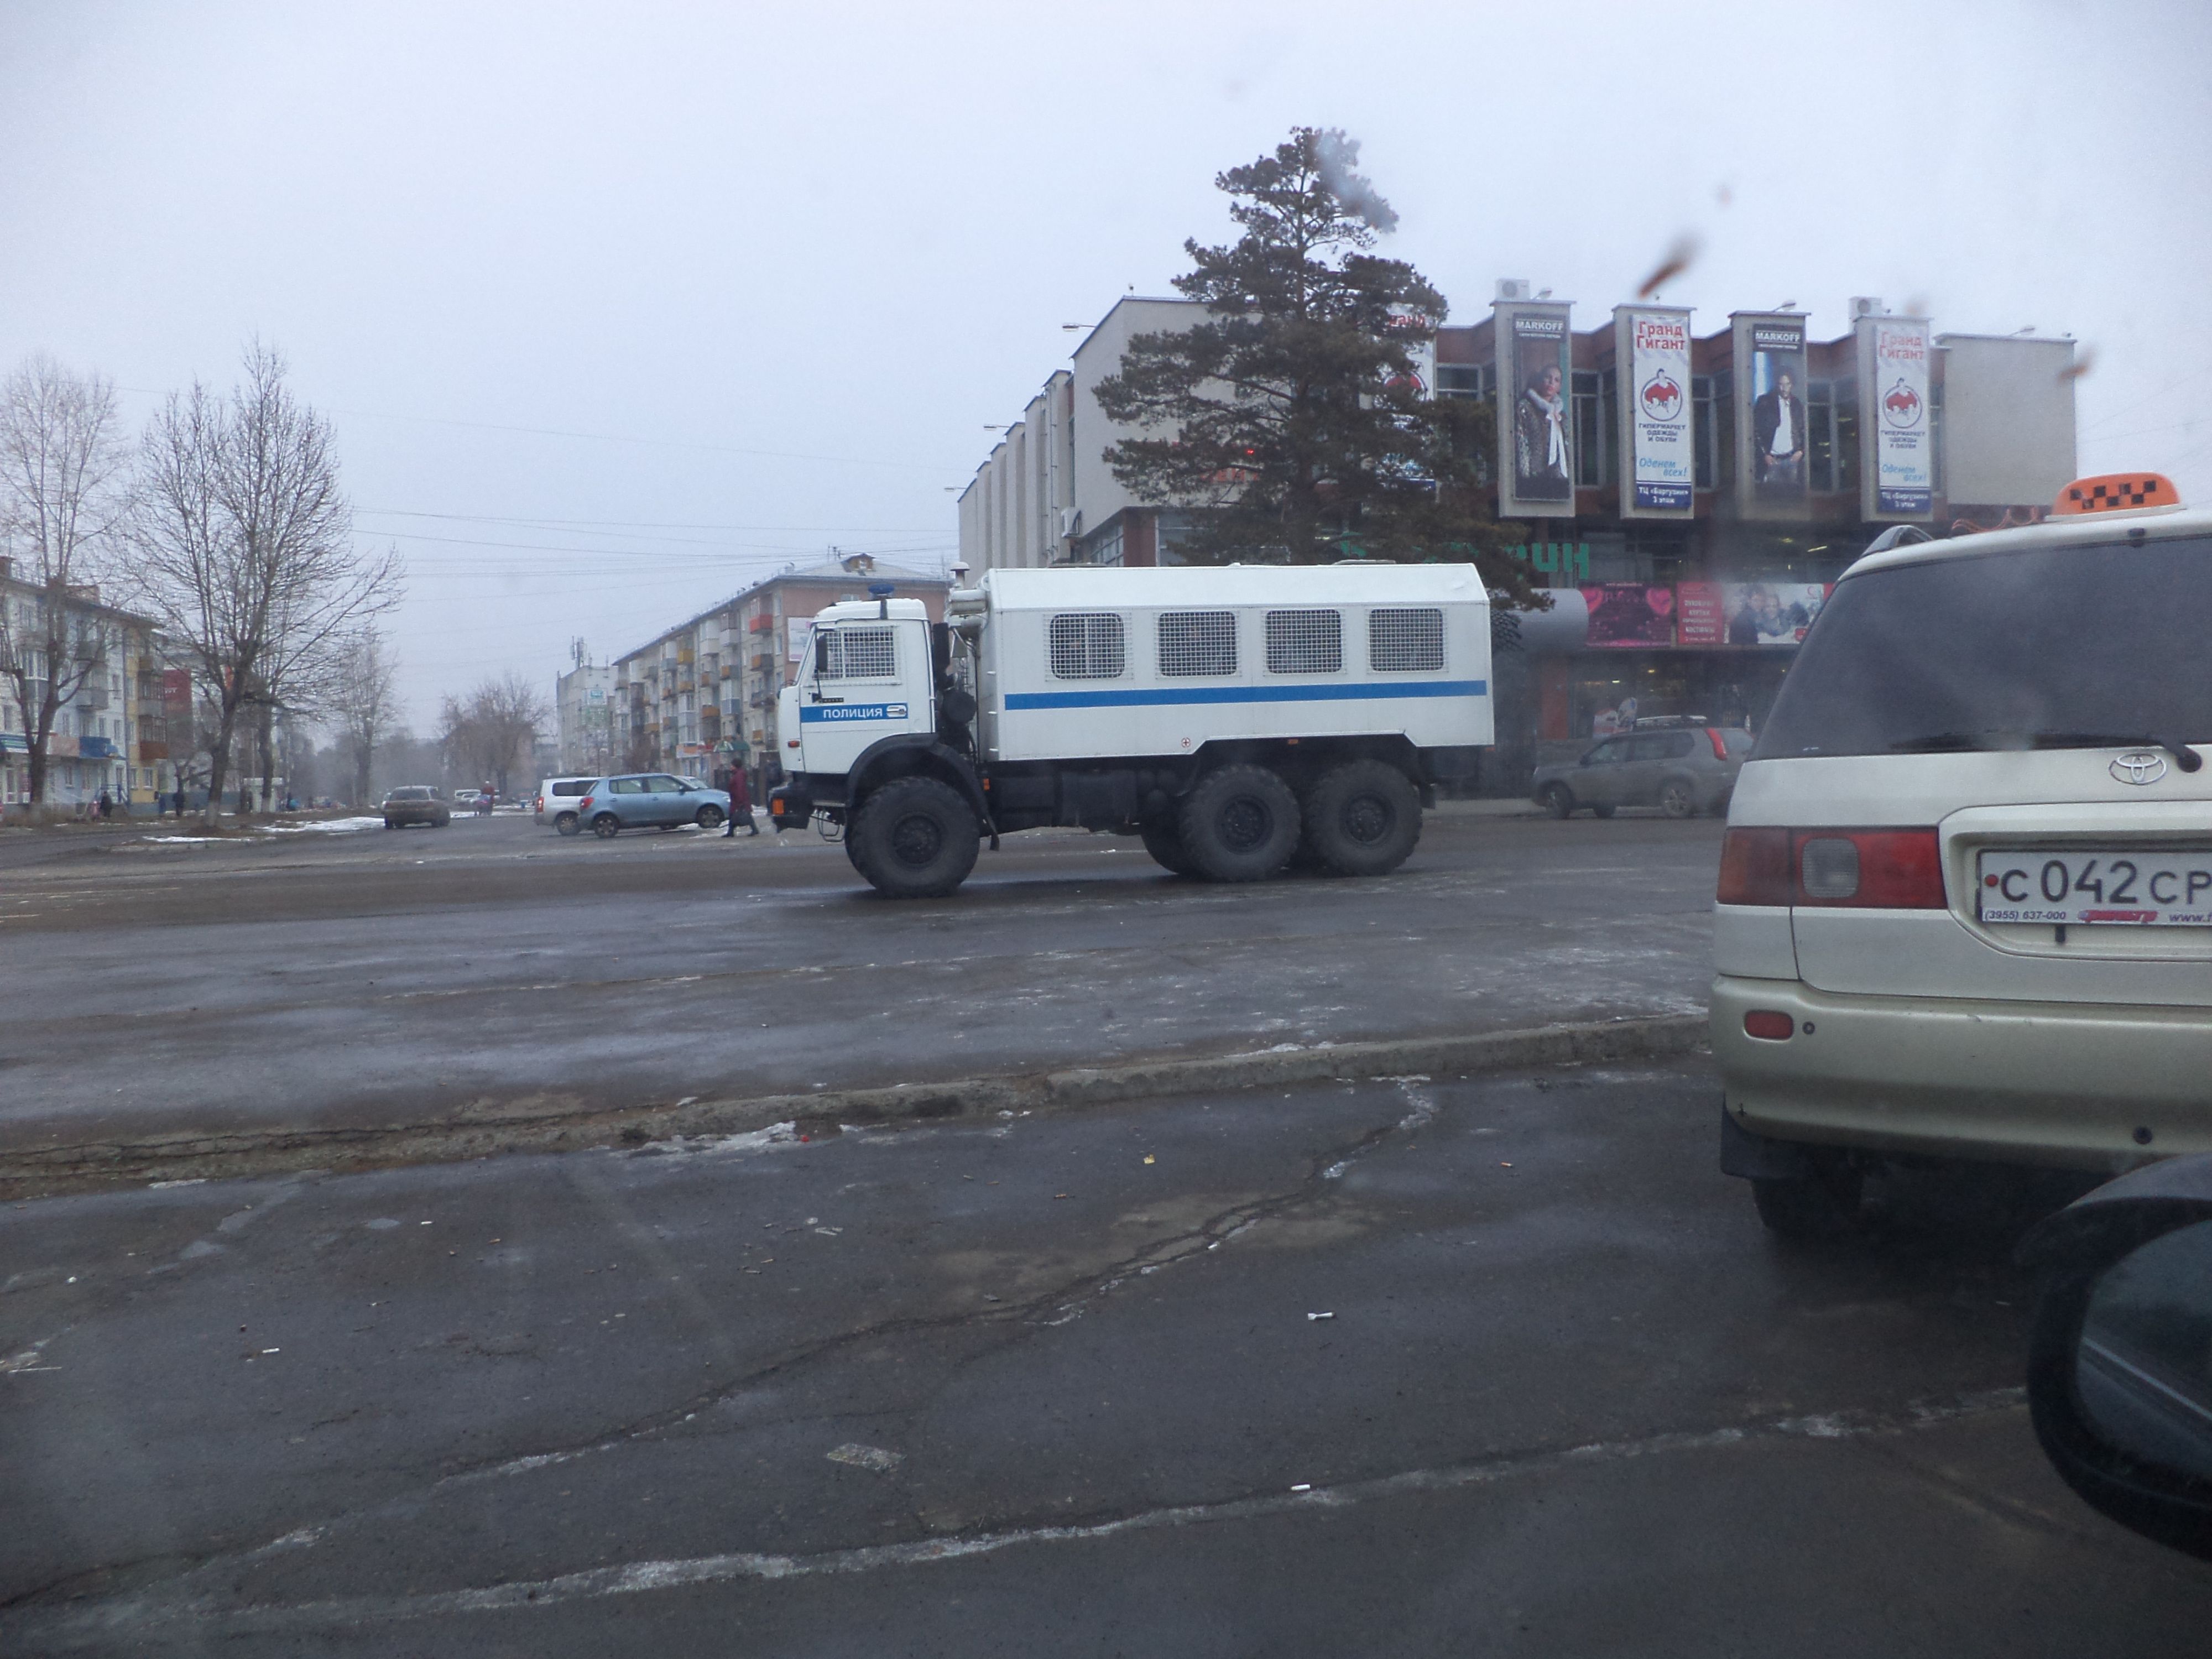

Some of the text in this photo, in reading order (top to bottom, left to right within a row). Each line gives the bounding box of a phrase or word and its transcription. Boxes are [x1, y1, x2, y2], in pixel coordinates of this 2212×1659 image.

[1515, 321, 1563, 331] MARKOFF
[1639, 321, 1682, 337] Гранд
[1636, 335, 1686, 350] Гигант
[1755, 332, 1801, 342] MARKOFF
[1639, 457, 1676, 468] Оденем
[1663, 466, 1687, 477] всех!
[822, 707, 883, 719] ПОЛИЦИЯ
[1984, 910, 2019, 920] (3955)
[2022, 911, 2067, 920] 637-000
